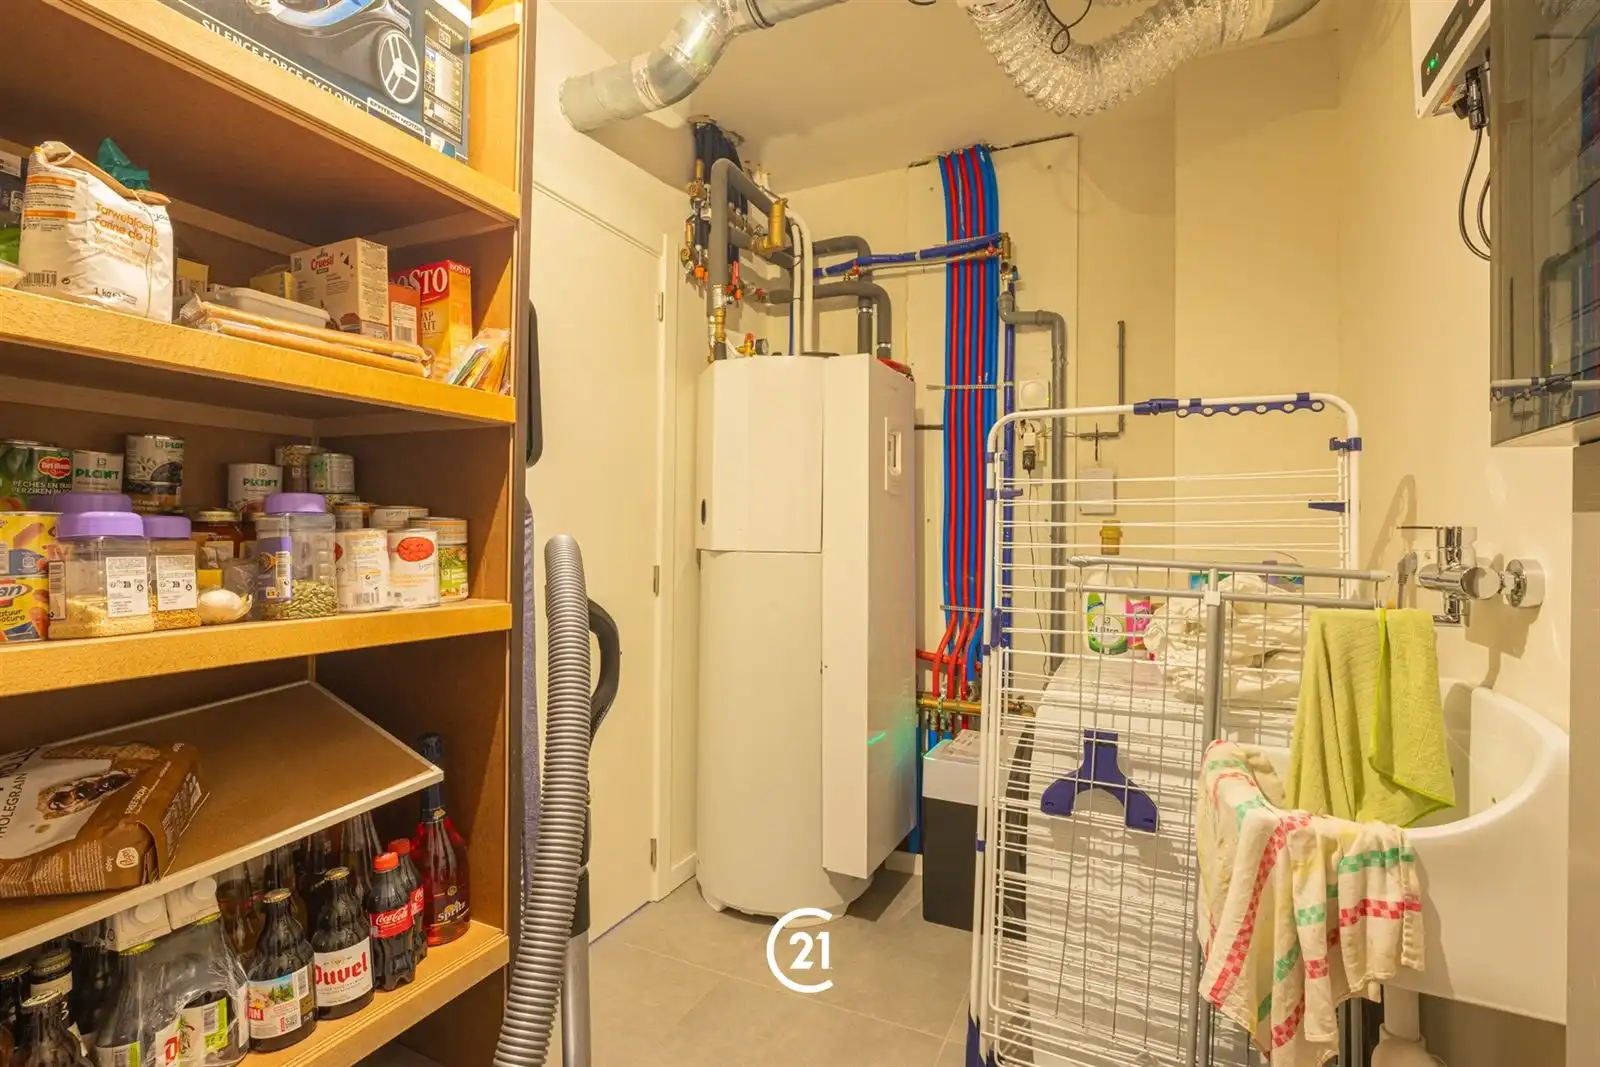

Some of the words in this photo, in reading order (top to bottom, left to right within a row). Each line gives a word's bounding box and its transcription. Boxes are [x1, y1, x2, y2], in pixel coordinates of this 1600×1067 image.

[128, 230, 143, 241] de
[389, 266, 448, 296] OSTO
[75, 468, 120, 480] PLANT
[243, 478, 278, 487] PLANT
[0, 586, 22, 597] an
[0, 609, 22, 618] atuur
[0, 614, 26, 623] ature
